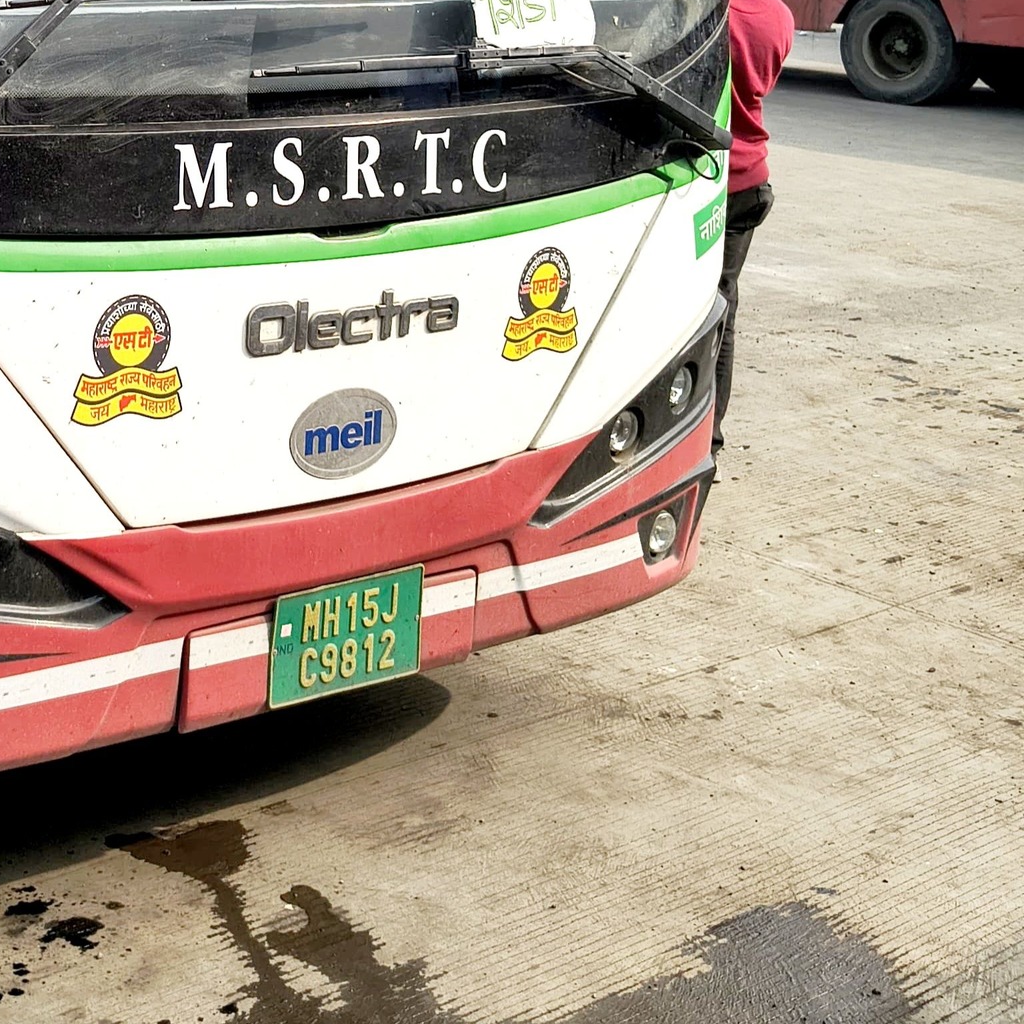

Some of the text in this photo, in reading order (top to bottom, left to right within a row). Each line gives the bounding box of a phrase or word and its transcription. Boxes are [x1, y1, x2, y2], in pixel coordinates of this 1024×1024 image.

[173, 128, 507, 211] M.S.R.T.C
[698, 201, 726, 241] नाशि
[244, 288, 460, 358] Olectra
[81, 371, 176, 397] महाराष्ट्र राज्य परिवहन
[90, 404, 110, 421] जय
[303, 409, 383, 457] meil
[299, 628, 396, 688] C9812
